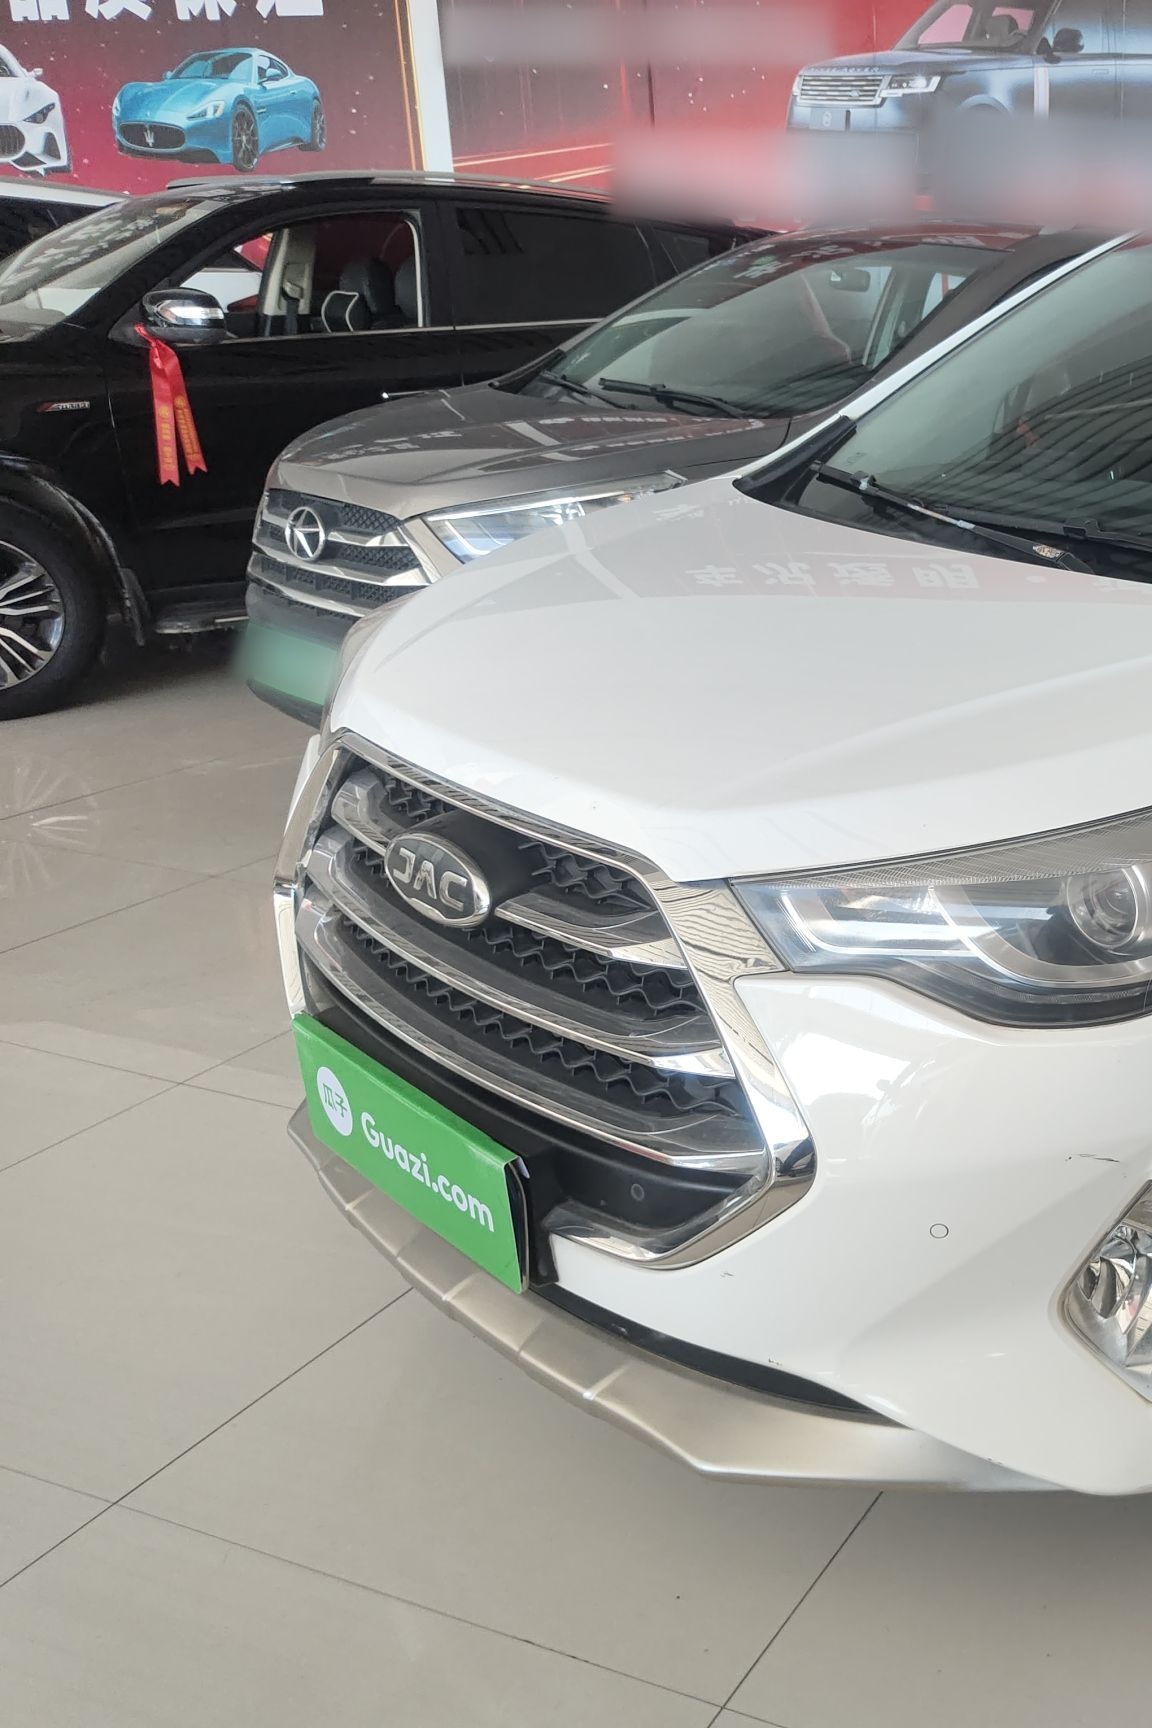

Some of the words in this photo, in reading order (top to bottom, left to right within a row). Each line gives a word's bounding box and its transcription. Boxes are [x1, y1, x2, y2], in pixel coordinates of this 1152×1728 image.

[393, 847, 468, 912] JAC
[322, 1083, 348, 1118] 瓜子
[361, 1112, 494, 1232] Guazi.com
